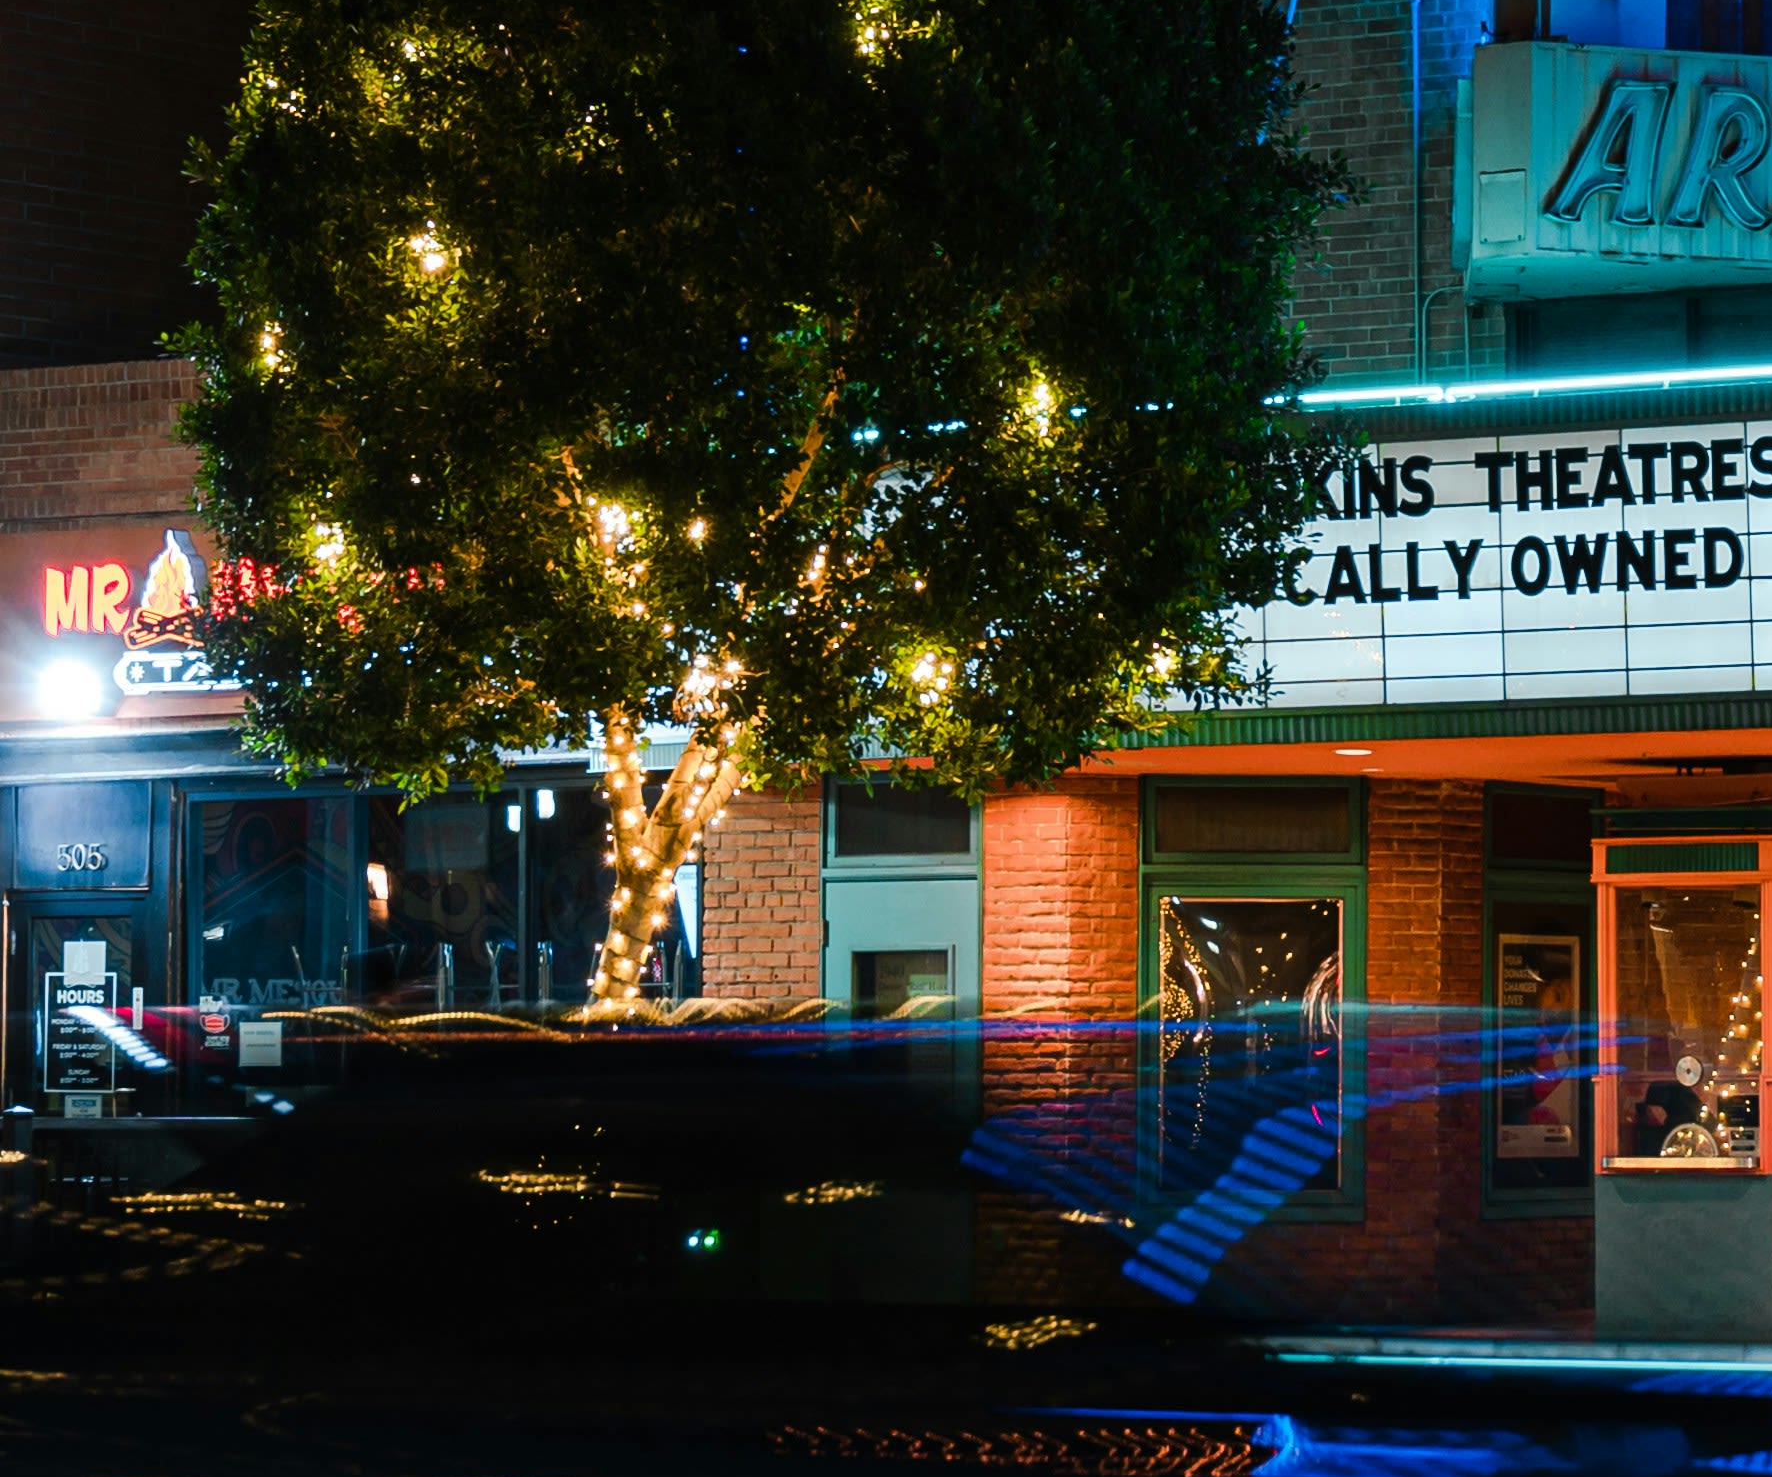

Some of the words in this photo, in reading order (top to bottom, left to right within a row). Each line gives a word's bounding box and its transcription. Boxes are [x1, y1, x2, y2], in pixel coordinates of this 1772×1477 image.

[1298, 455, 1435, 521] KINS
[1282, 538, 1484, 606] CALLY
[1510, 527, 1745, 596] OWNED
[43, 564, 131, 636] MR
[57, 843, 103, 871] 505
[56, 989, 105, 1004] HOURS
[1503, 969, 1540, 979] DONATN
